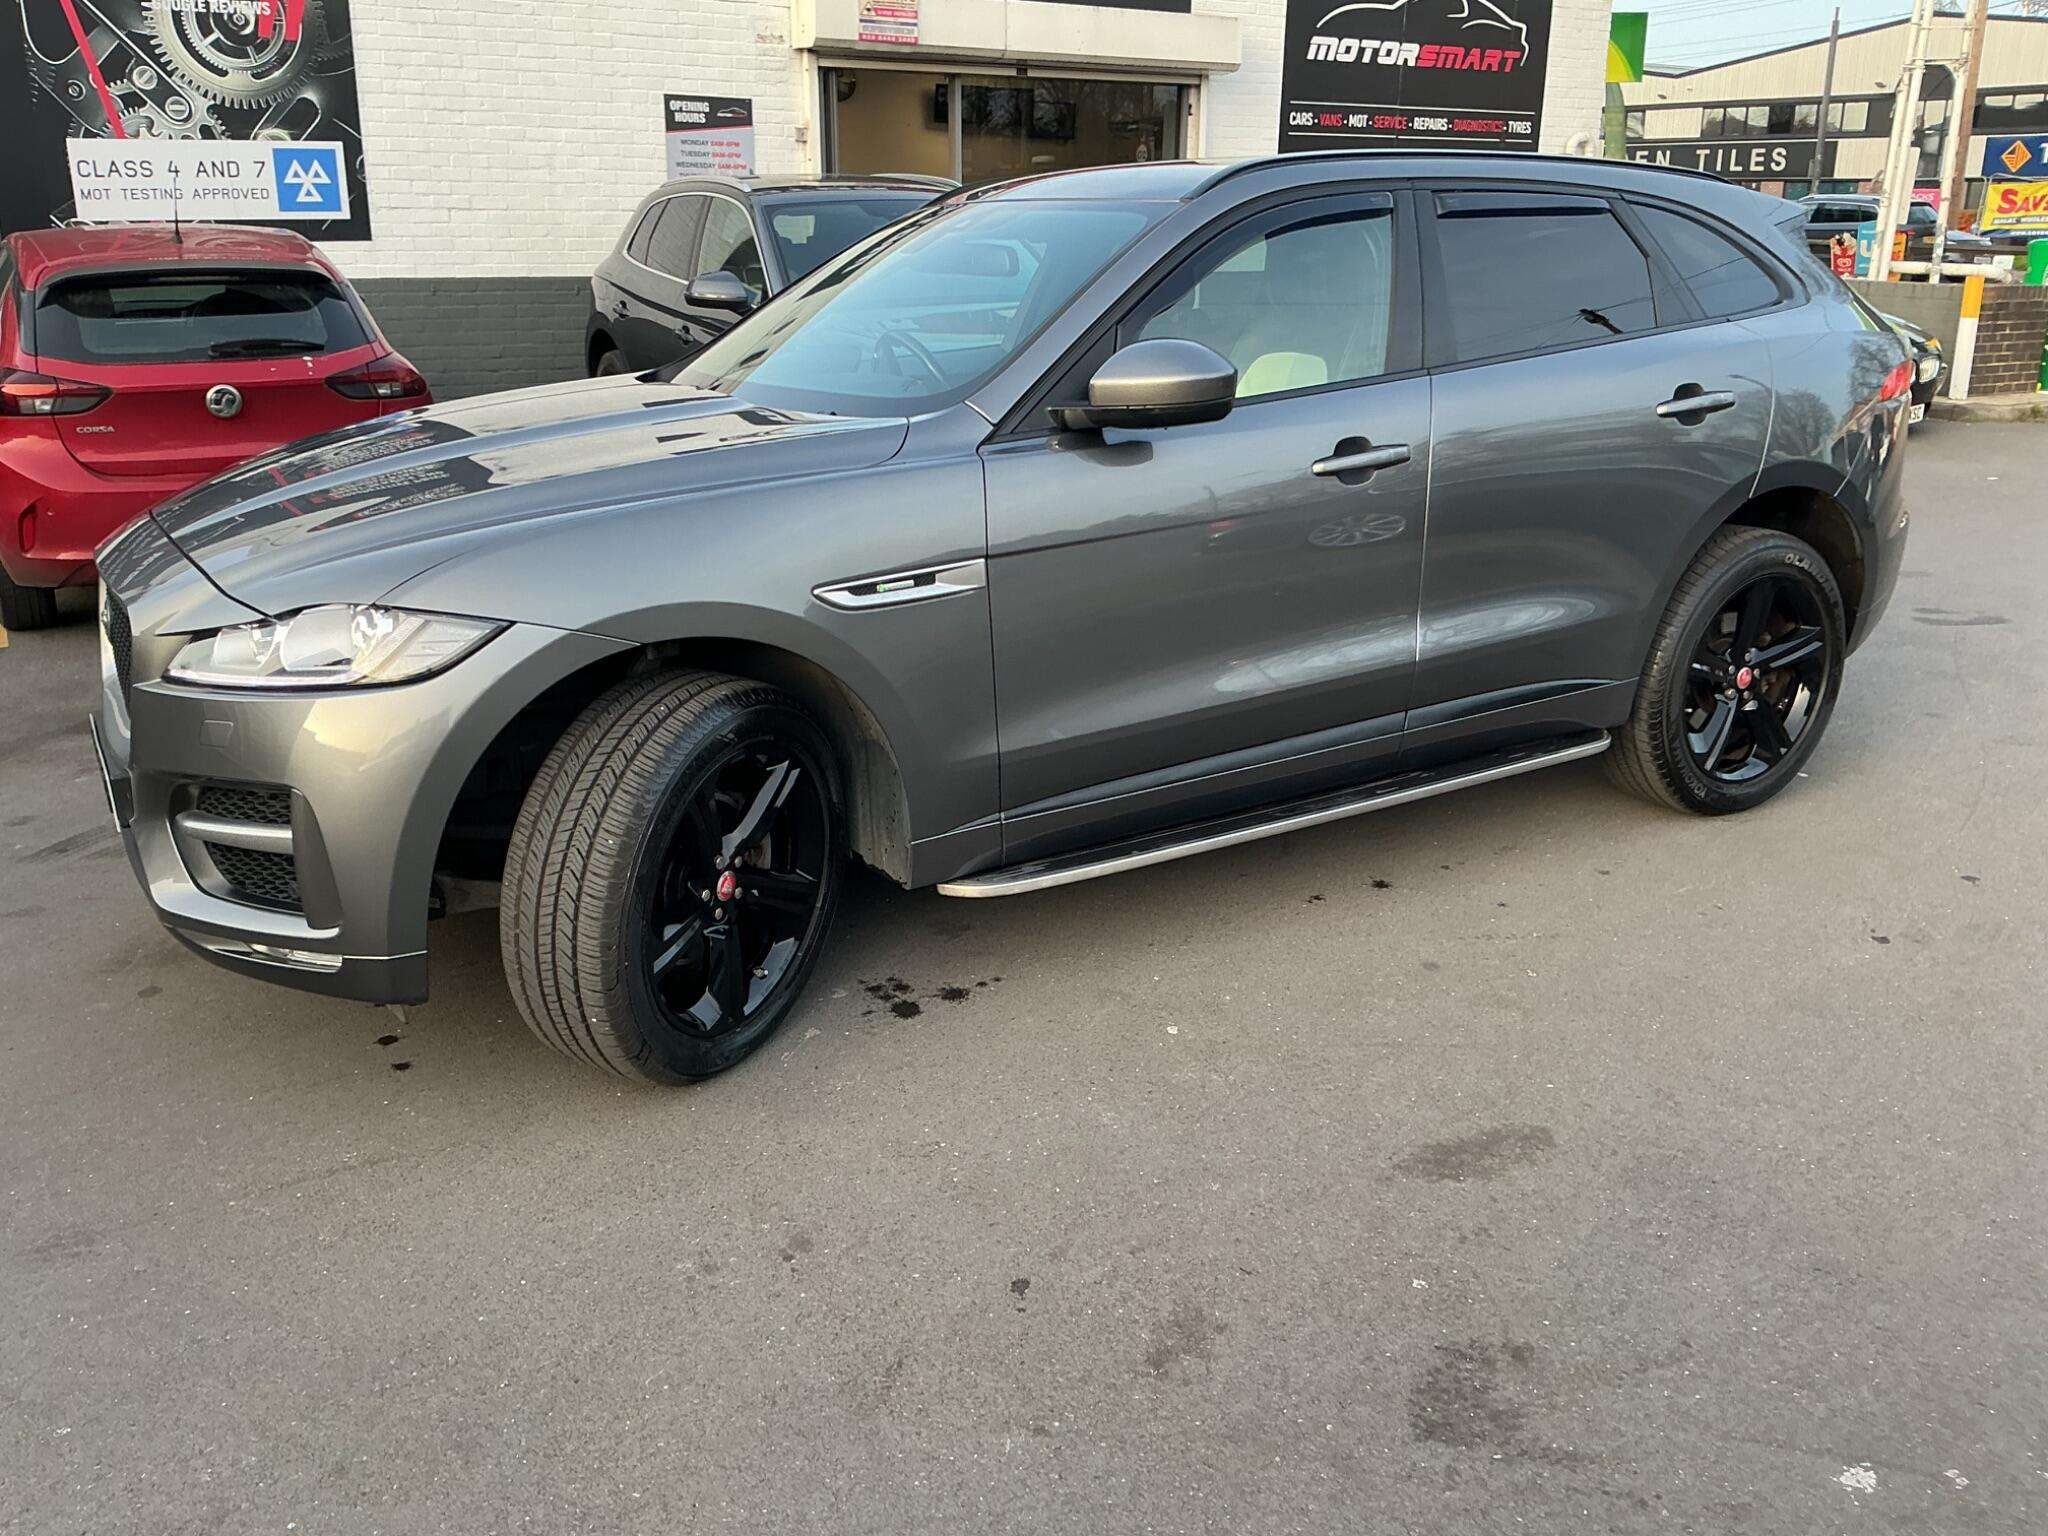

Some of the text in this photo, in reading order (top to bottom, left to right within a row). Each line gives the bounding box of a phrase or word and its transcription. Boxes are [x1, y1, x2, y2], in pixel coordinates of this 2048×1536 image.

[211, 1, 271, 16] REVIEWS
[1306, 36, 1521, 72] MOTORSMART
[669, 100, 710, 112] OPENING
[675, 112, 706, 123] HOURS
[1289, 112, 1532, 134] CARS VANS MOT SERVICE REPAIRS DIAGNOSTICS TYRES
[1695, 147, 1788, 172] TILES
[77, 160, 266, 178] CLASS 4 AND 7
[80, 188, 270, 200] MOT TESTING APPROVED
[76, 425, 115, 434] CORSA
